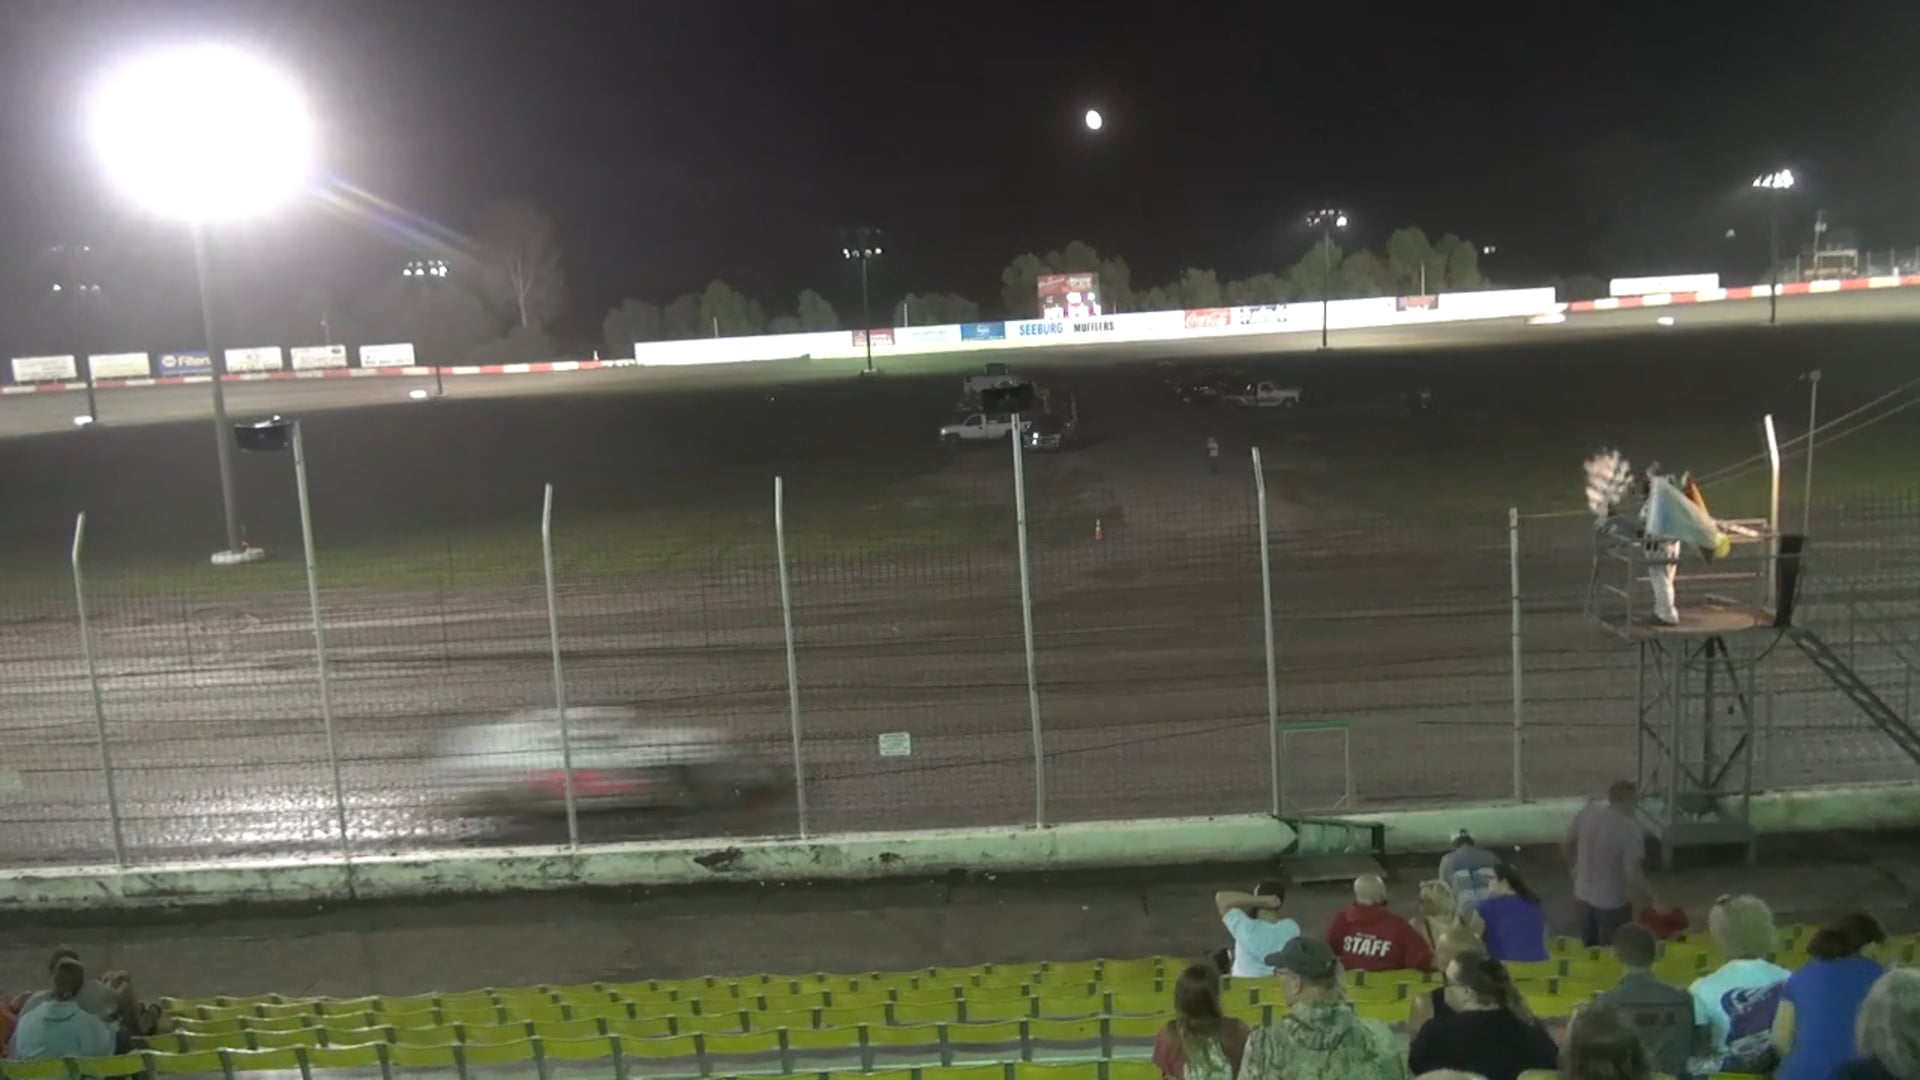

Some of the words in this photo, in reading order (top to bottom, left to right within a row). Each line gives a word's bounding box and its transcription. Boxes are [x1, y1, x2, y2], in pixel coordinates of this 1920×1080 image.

[1019, 323, 1063, 336] SEEBURG
[1073, 321, 1114, 333] MUFFLERS
[1343, 935, 1392, 957] STAFF
